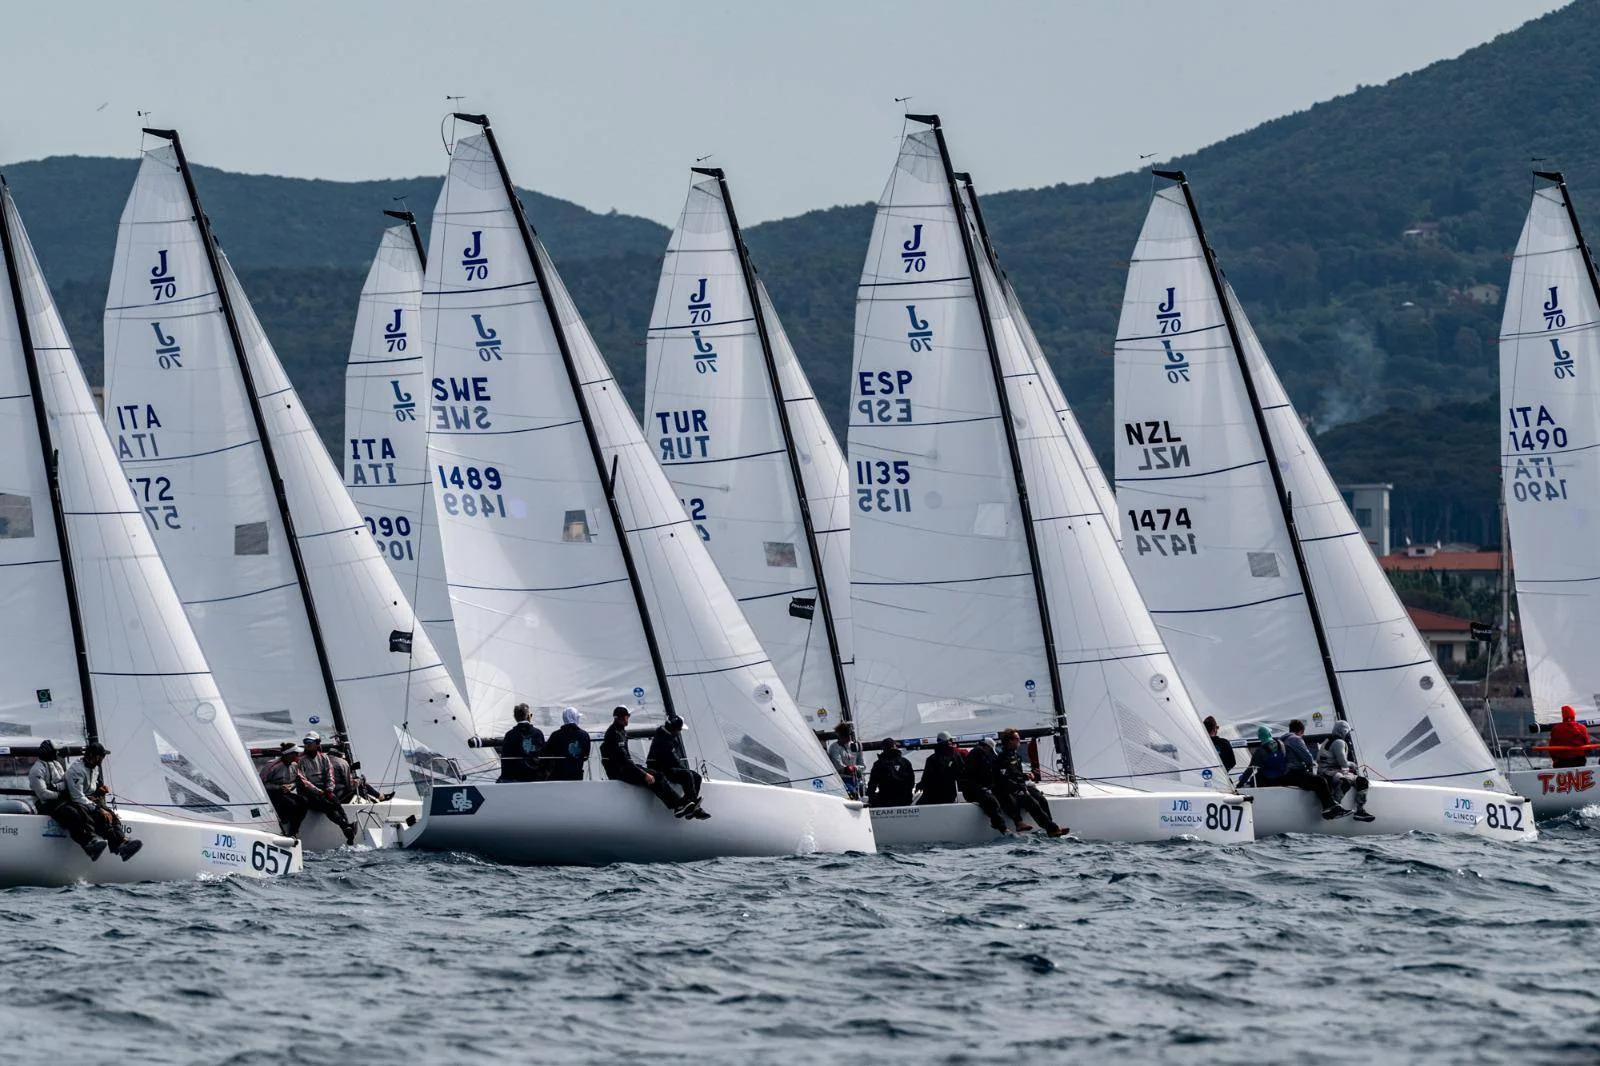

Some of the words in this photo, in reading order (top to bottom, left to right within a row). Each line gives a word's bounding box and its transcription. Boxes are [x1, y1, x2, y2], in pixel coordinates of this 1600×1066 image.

[463, 231, 482, 258] J
[903, 224, 923, 251] J
[151, 249, 168, 278] J
[465, 264, 489, 281] 70
[904, 257, 927, 273] 70
[153, 283, 176, 301] 70
[690, 278, 708, 303] J
[1158, 287, 1176, 313] J
[1543, 286, 1558, 311] J
[384, 309, 403, 333] J
[690, 309, 712, 324] 70
[1159, 318, 1182, 334] 70
[1545, 314, 1566, 330] 70
[387, 339, 407, 353] 70
[432, 377, 491, 402] SWE
[859, 370, 913, 396] ESP
[117, 403, 161, 430] ITA
[656, 409, 708, 434] TUR
[1509, 405, 1555, 428] ITA
[1125, 420, 1182, 446] NZL
[1509, 427, 1568, 451] 1490
[351, 438, 396, 460] ITA
[439, 466, 502, 491] 1489
[856, 461, 910, 485] 1135
[1128, 507, 1192, 531] 1474
[1169, 815, 1202, 823] LINCOLN
[1205, 802, 1244, 832] 807
[1486, 802, 1525, 832] 812
[212, 851, 247, 863] LINCOLN
[251, 840, 293, 876] 657
